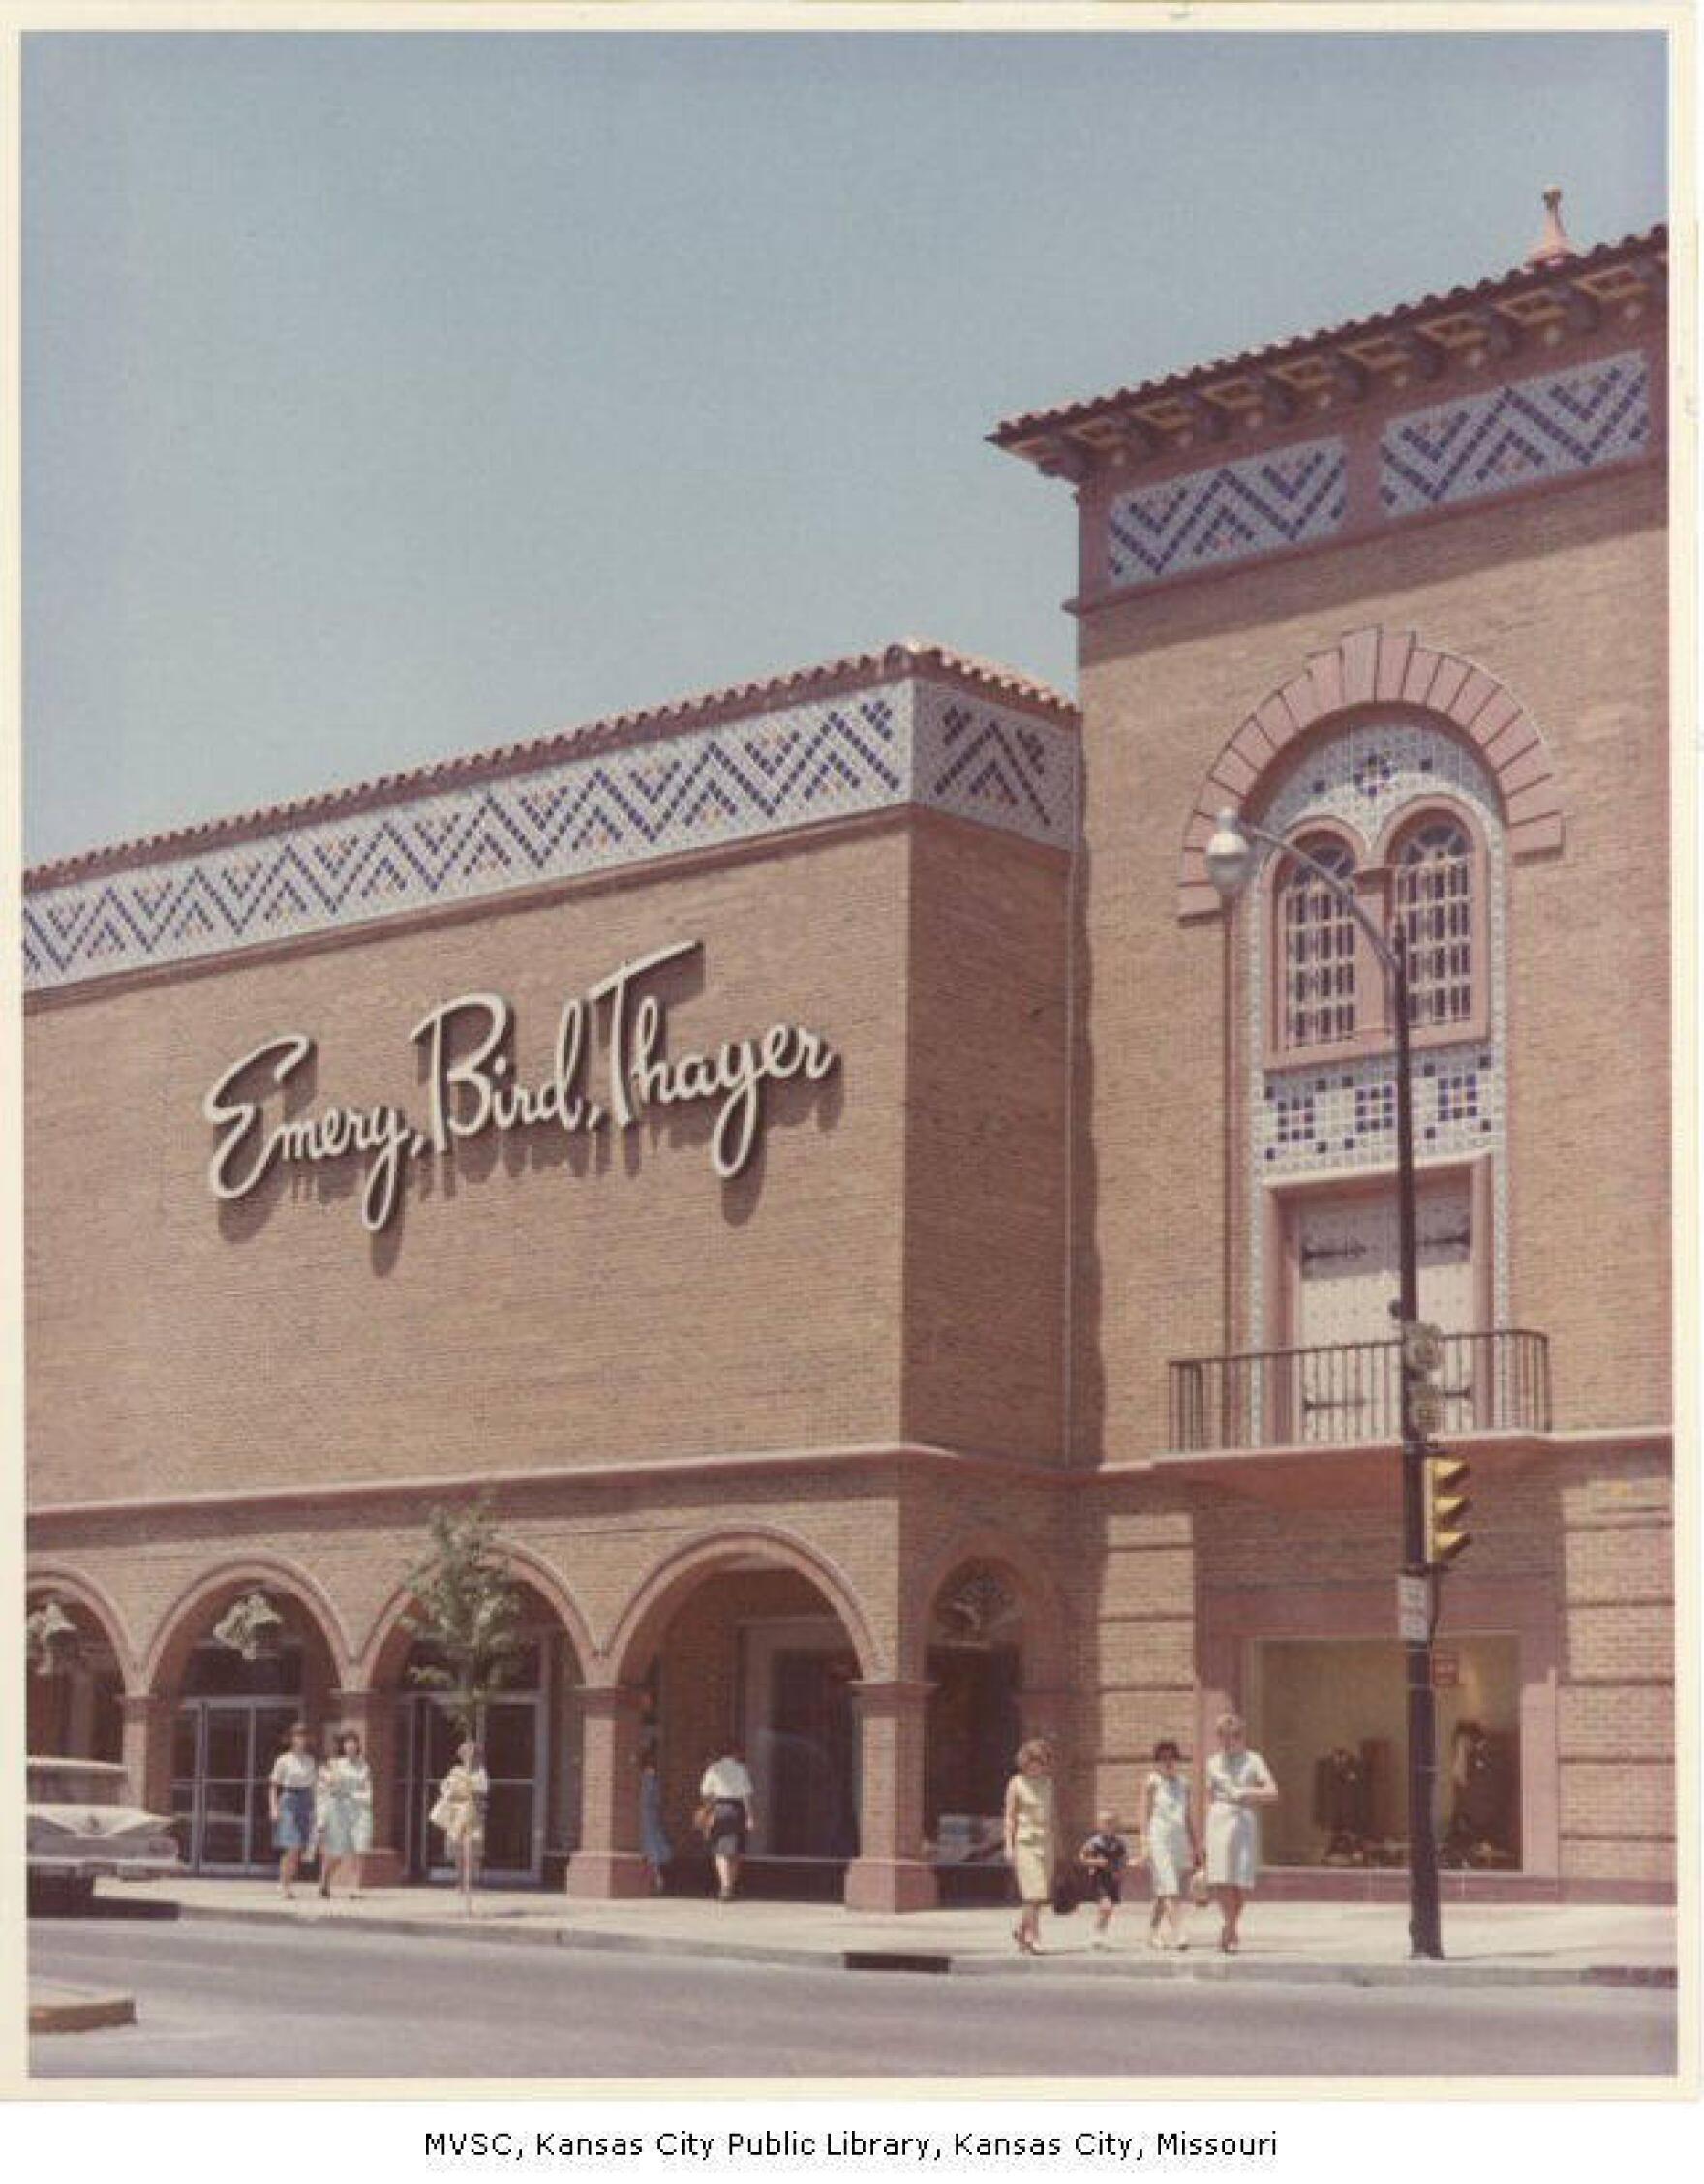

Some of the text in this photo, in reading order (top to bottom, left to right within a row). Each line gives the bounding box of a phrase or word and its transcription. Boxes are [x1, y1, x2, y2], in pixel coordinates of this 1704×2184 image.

[202, 939, 835, 1231] Emery, Bird, Thayer
